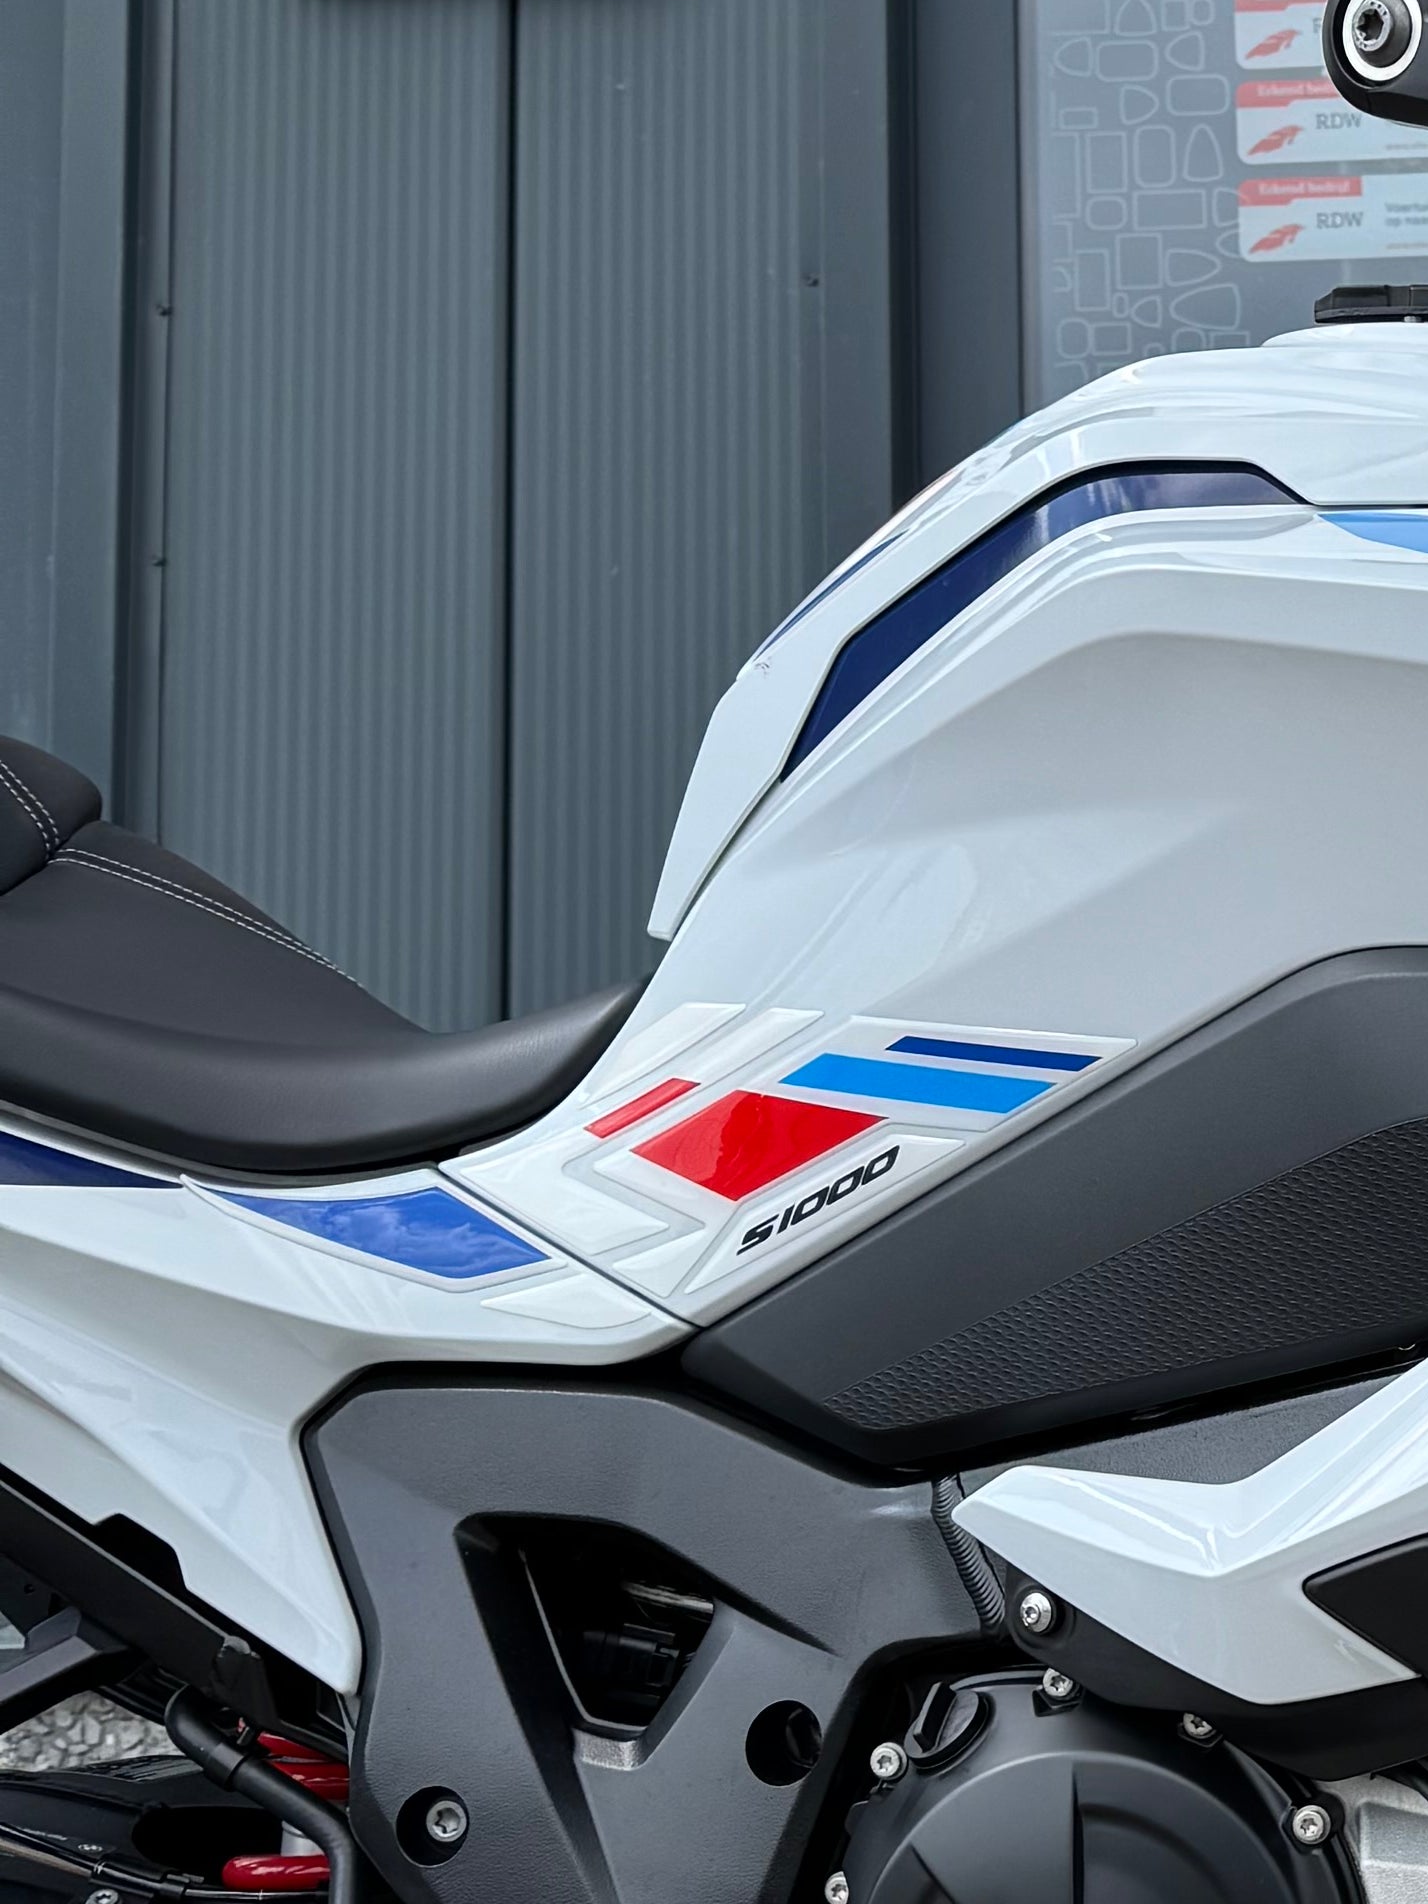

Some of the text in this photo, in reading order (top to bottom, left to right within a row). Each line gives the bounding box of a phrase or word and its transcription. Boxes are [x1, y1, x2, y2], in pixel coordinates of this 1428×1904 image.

[1316, 113, 1362, 130] RDW
[1316, 212, 1364, 230] RDW
[736, 1144, 900, 1256] S1000
